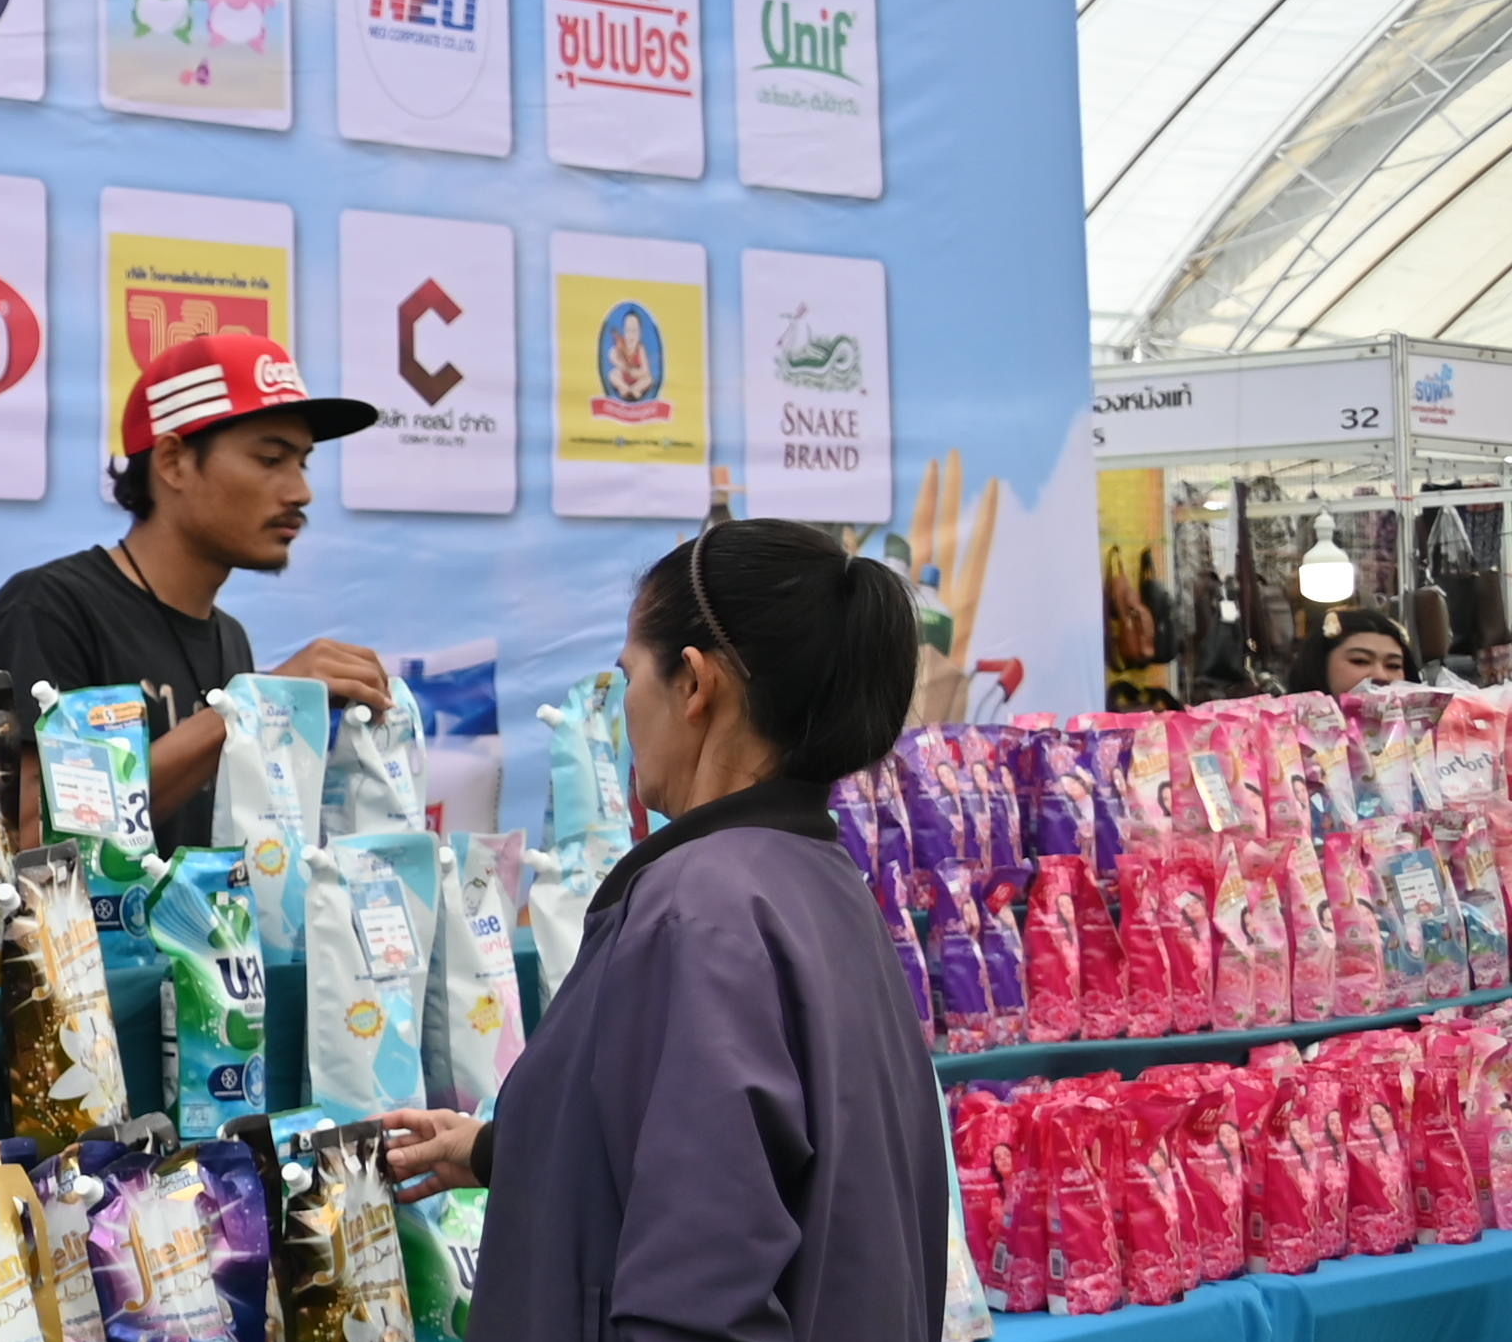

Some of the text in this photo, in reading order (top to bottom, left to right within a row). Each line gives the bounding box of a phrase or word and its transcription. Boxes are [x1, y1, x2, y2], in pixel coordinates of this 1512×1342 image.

[556, 10, 693, 89] ซุปเปอร์
[1093, 381, 1193, 414] องหนังแท้
[780, 401, 860, 439] SNAKE
[1340, 406, 1380, 429] 32
[782, 444, 860, 472] BRAND
